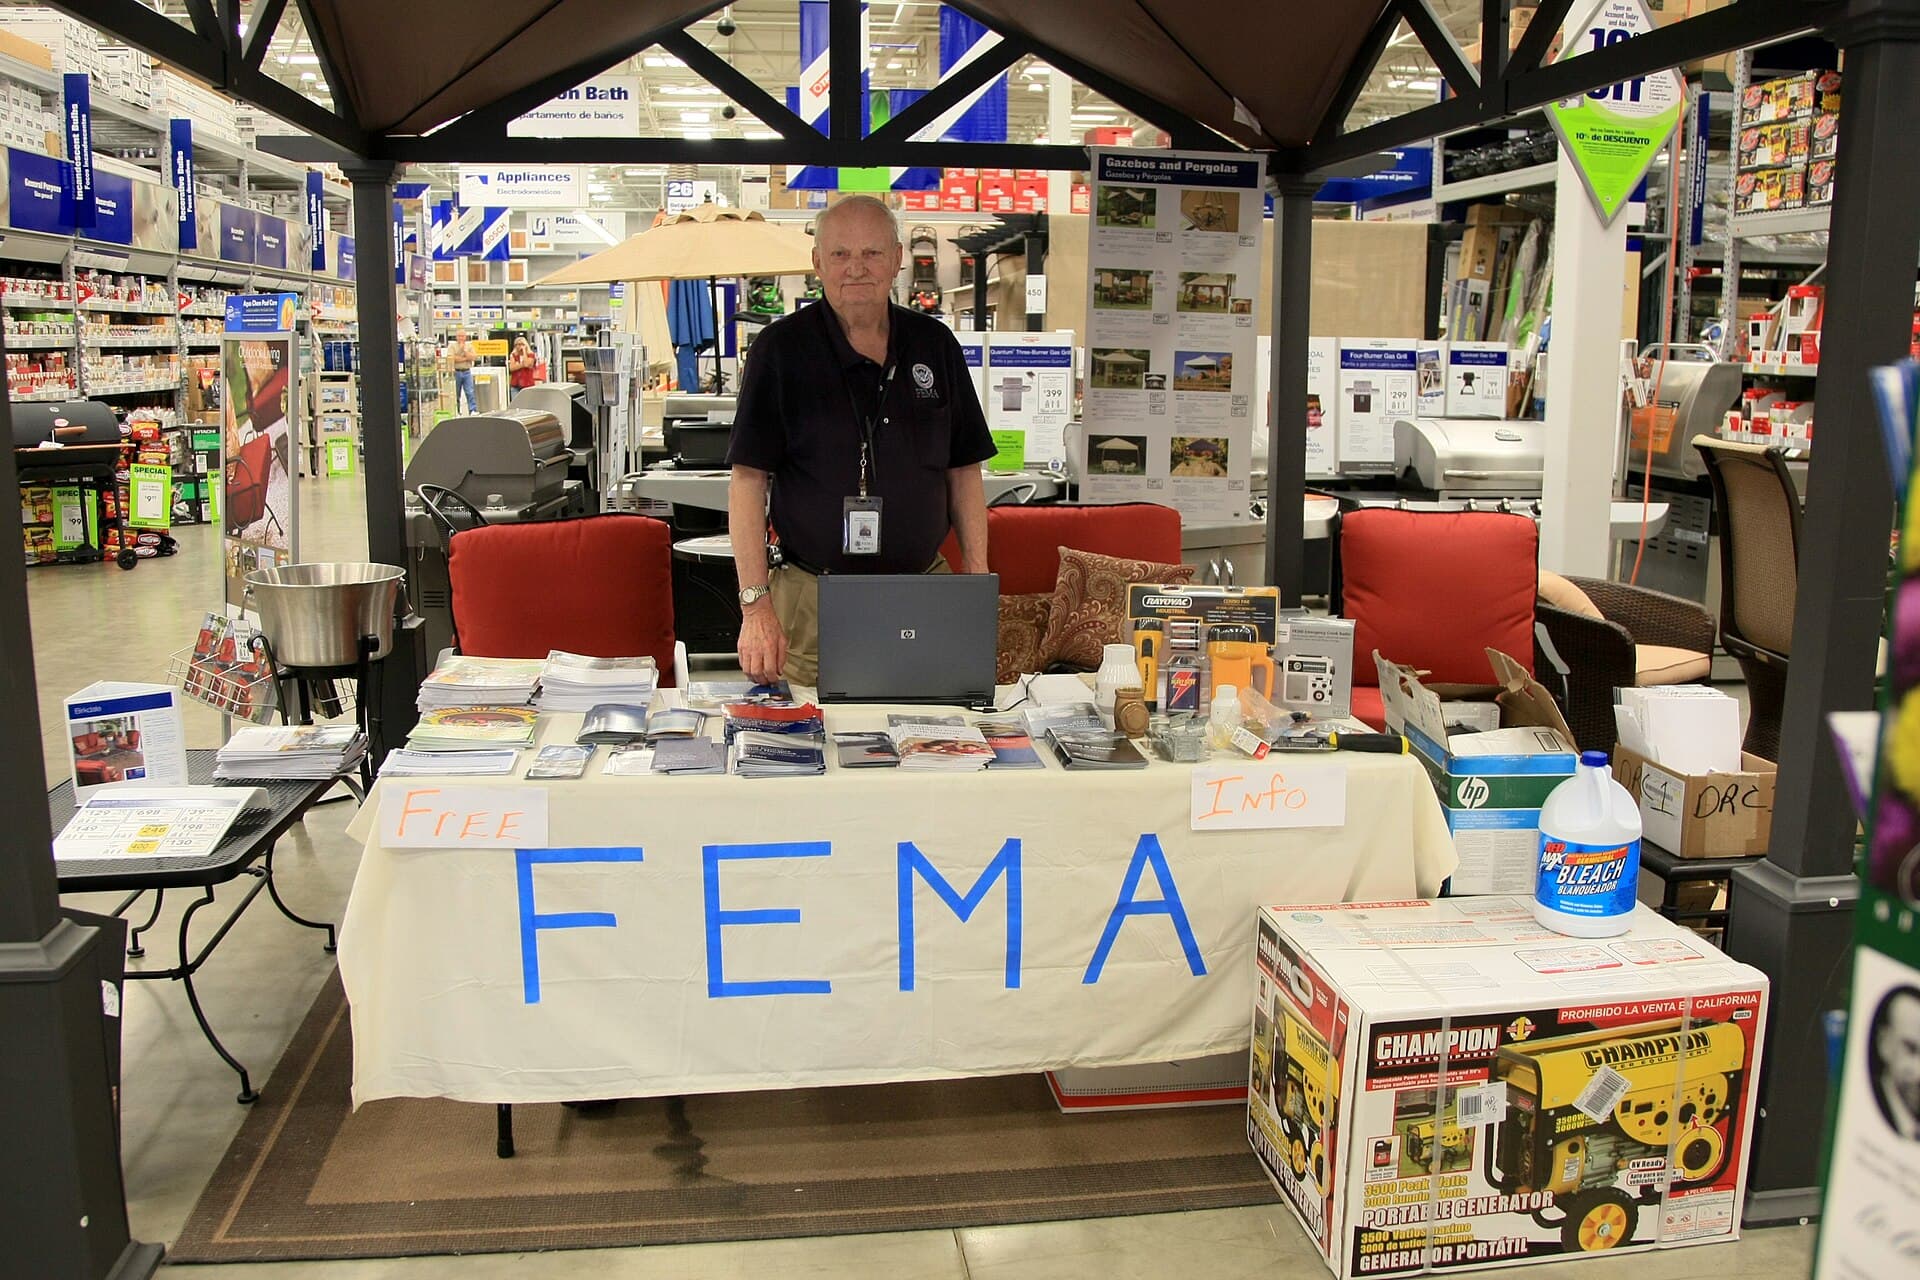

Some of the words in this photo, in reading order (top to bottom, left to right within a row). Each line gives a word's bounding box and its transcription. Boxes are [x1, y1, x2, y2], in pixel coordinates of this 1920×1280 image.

[1613, 3, 1624, 11] Open
[1625, 12, 1639, 20] Today
[586, 86, 628, 100] Bath
[71, 103, 80, 132] Bulbs
[519, 110, 577, 121] partamento
[579, 110, 592, 120] de
[1604, 135, 1650, 145] DESCUENTO
[73, 132, 84, 200] Incandescent
[1105, 157, 1156, 169] Gazebos
[1159, 160, 1182, 171] and
[1185, 162, 1238, 175] Pergolas
[1105, 170, 1135, 179] Gazebos
[83, 168, 91, 189] Focos
[497, 171, 571, 184] Appliances
[668, 182, 693, 197] 26
[484, 222, 507, 246] BOSCH
[1390, 391, 1408, 399] $299
[134, 466, 167, 474] SPECIAL
[1146, 597, 1189, 606] RAYOVAC
[1461, 776, 1486, 809] hp
[1693, 783, 1768, 819] DRC
[1541, 852, 1568, 871] MAX
[1556, 857, 1626, 885] BLEACH
[1557, 880, 1618, 896] BLANQUEADOR
[515, 833, 1208, 1005] FEMA
[1561, 1006, 1622, 1021] PROHIBIDO
[1624, 1004, 1639, 1015] LA
[1641, 1002, 1676, 1014] VENTA
[1695, 994, 1758, 1009] CALIFORNIA
[1376, 1027, 1499, 1060] CHAMPION
[1585, 1031, 1710, 1067] CHAMPION
[1378, 1058, 1420, 1066] POWER
[1425, 1051, 1495, 1062] EQIPMENT
[1591, 1062, 1634, 1073] PWER
[1640, 1049, 1709, 1065] EQUIPENT
[1555, 1121, 1585, 1134] 3000W
[1556, 1113, 1586, 1126] 3500W
[1631, 1161, 1641, 1169] RV
[1642, 1159, 1663, 1169] Ready
[1249, 1119, 1285, 1181] PORTABLE
[1284, 1169, 1323, 1240] GENERATO
[1365, 1181, 1398, 1197] 3500
[1400, 1178, 1430, 1192] Peak
[1438, 1175, 1468, 1188] atts
[1364, 1194, 1393, 1208] 3000
[1392, 1192, 1430, 1205] Runnin
[1438, 1187, 1468, 1199] Watts
[1689, 1187, 1714, 1195] PELIGRO
[1362, 1200, 1452, 1227] PORTABLE
[1453, 1190, 1554, 1217] GENERATOR
[1360, 1243, 1385, 1254] 3000
[1385, 1240, 1398, 1250] de
[1399, 1237, 1427, 1249] vatios
[1433, 1233, 1474, 1246] ontinuos
[1361, 1230, 1390, 1244] 3500
[1392, 1227, 1427, 1241] Vatios
[1359, 1246, 1453, 1272] GENERAOR
[1455, 1236, 1529, 1261] PORTÁTIL
